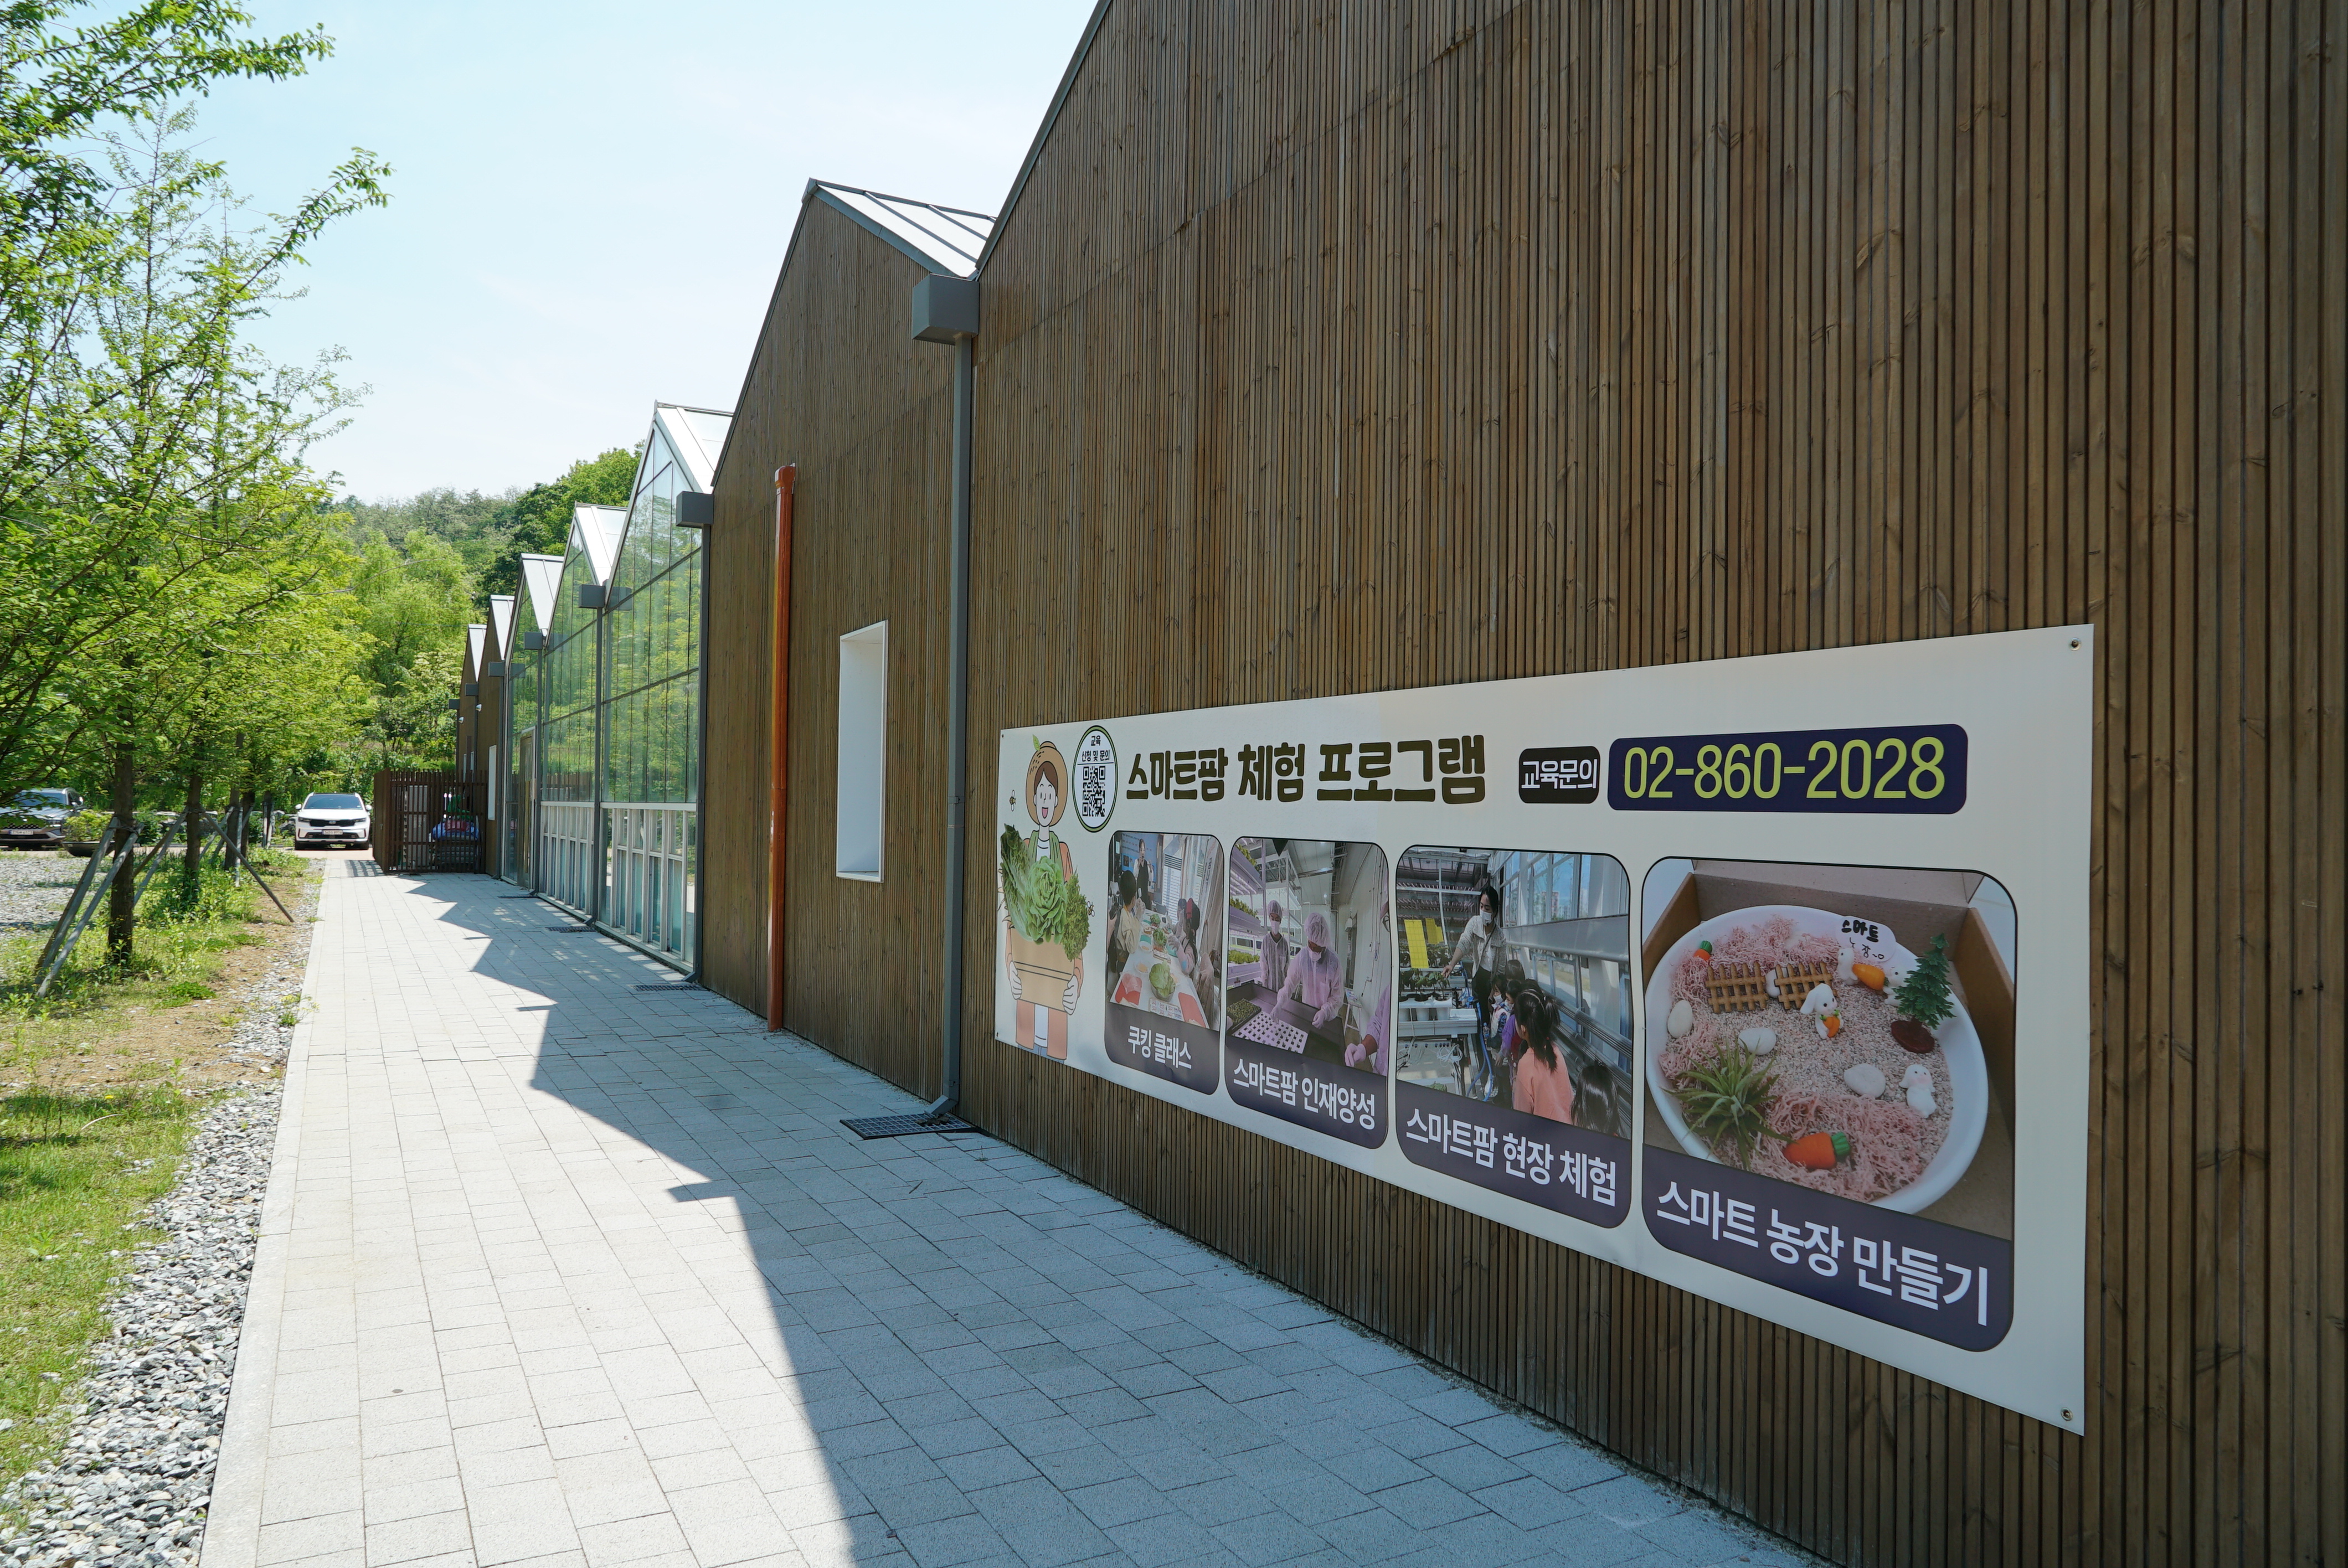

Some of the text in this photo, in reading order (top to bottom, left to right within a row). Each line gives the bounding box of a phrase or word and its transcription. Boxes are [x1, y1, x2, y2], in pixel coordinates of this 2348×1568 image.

[1082, 749, 1110, 762] 신청 및 문의
[1091, 735, 1101, 746] 교육
[1126, 735, 1485, 804] 스마트팜 체험 프로그램
[1521, 737, 1945, 799] 교육문의 02-860-2028
[1841, 920, 1879, 942] 스마트
[1128, 1025, 1192, 1069] 쿠킹 클래스
[1233, 1058, 1375, 1130] 스마트팜 인재양성
[1406, 1108, 1615, 1207] 스마트팜 현장 체험
[1657, 1181, 1987, 1327] 스마트 농장 만들기
